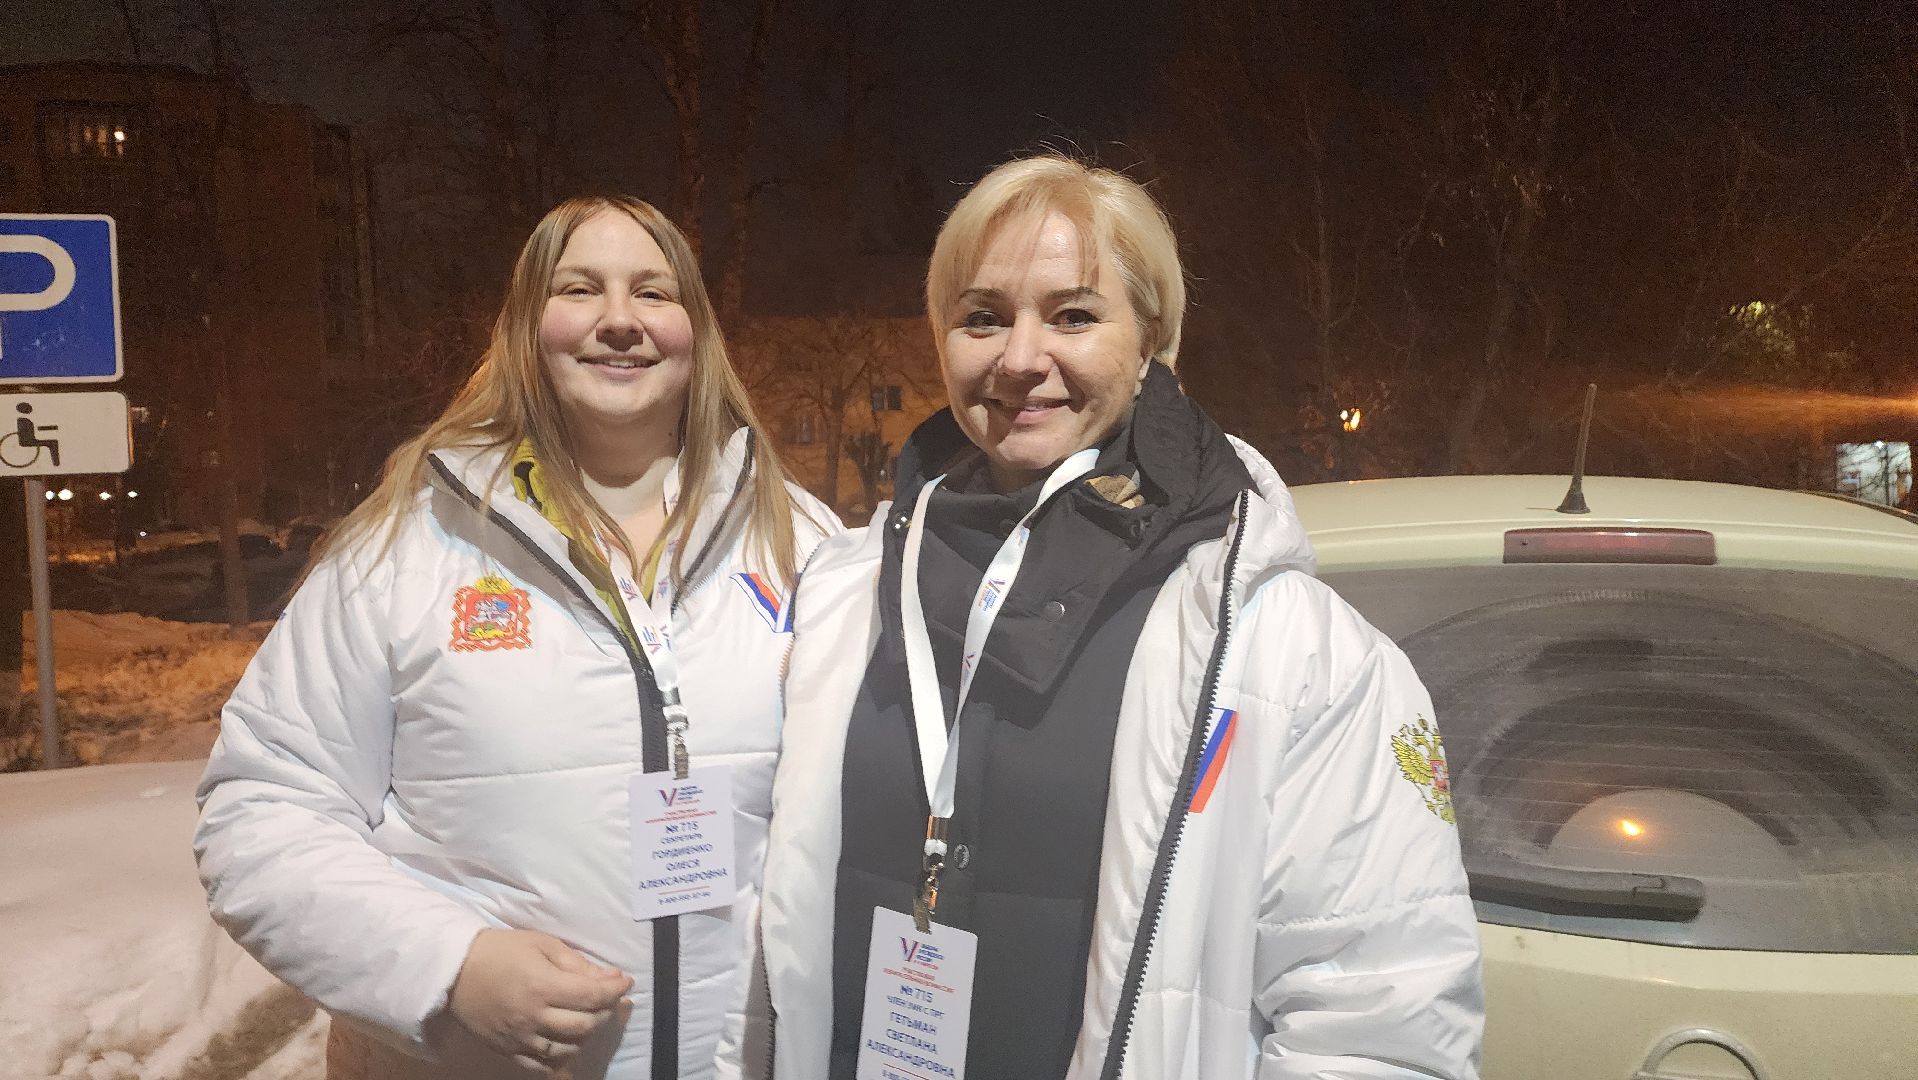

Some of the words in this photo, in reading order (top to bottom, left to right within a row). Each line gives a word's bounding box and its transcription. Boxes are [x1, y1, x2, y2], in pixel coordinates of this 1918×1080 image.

[666, 858, 701, 871] ОЛЕСЯ
[638, 867, 729, 890] АЛЕКСАНДРОВНА
[916, 988, 934, 1003] 715
[890, 1011, 937, 1035] ГЕТЬМАН
[886, 1028, 938, 1054] СВЕТЛАНА
[866, 1038, 956, 1078] АЛЕКСАНДРОВНА
